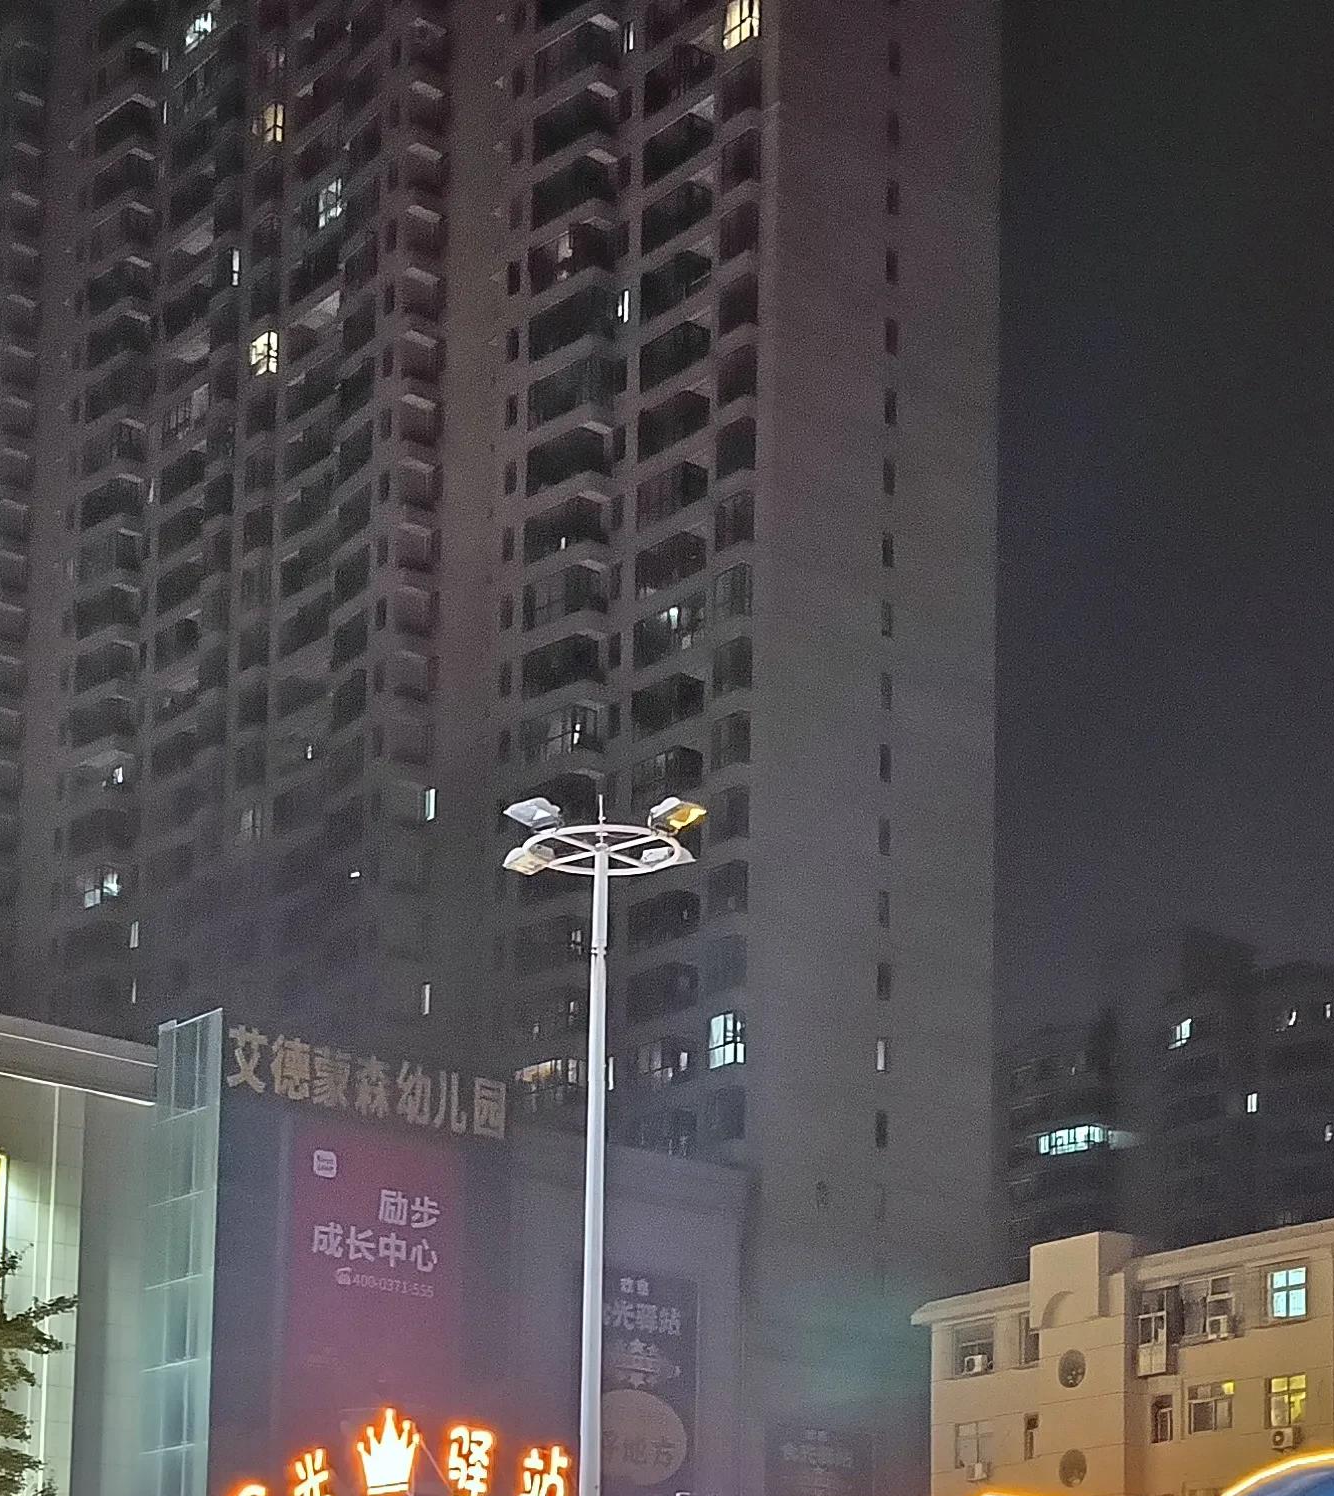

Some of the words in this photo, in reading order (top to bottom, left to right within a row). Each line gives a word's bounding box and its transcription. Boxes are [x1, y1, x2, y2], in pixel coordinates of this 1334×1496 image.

[378, 1189, 441, 1229] 励步
[312, 1221, 438, 1273] 成长中心
